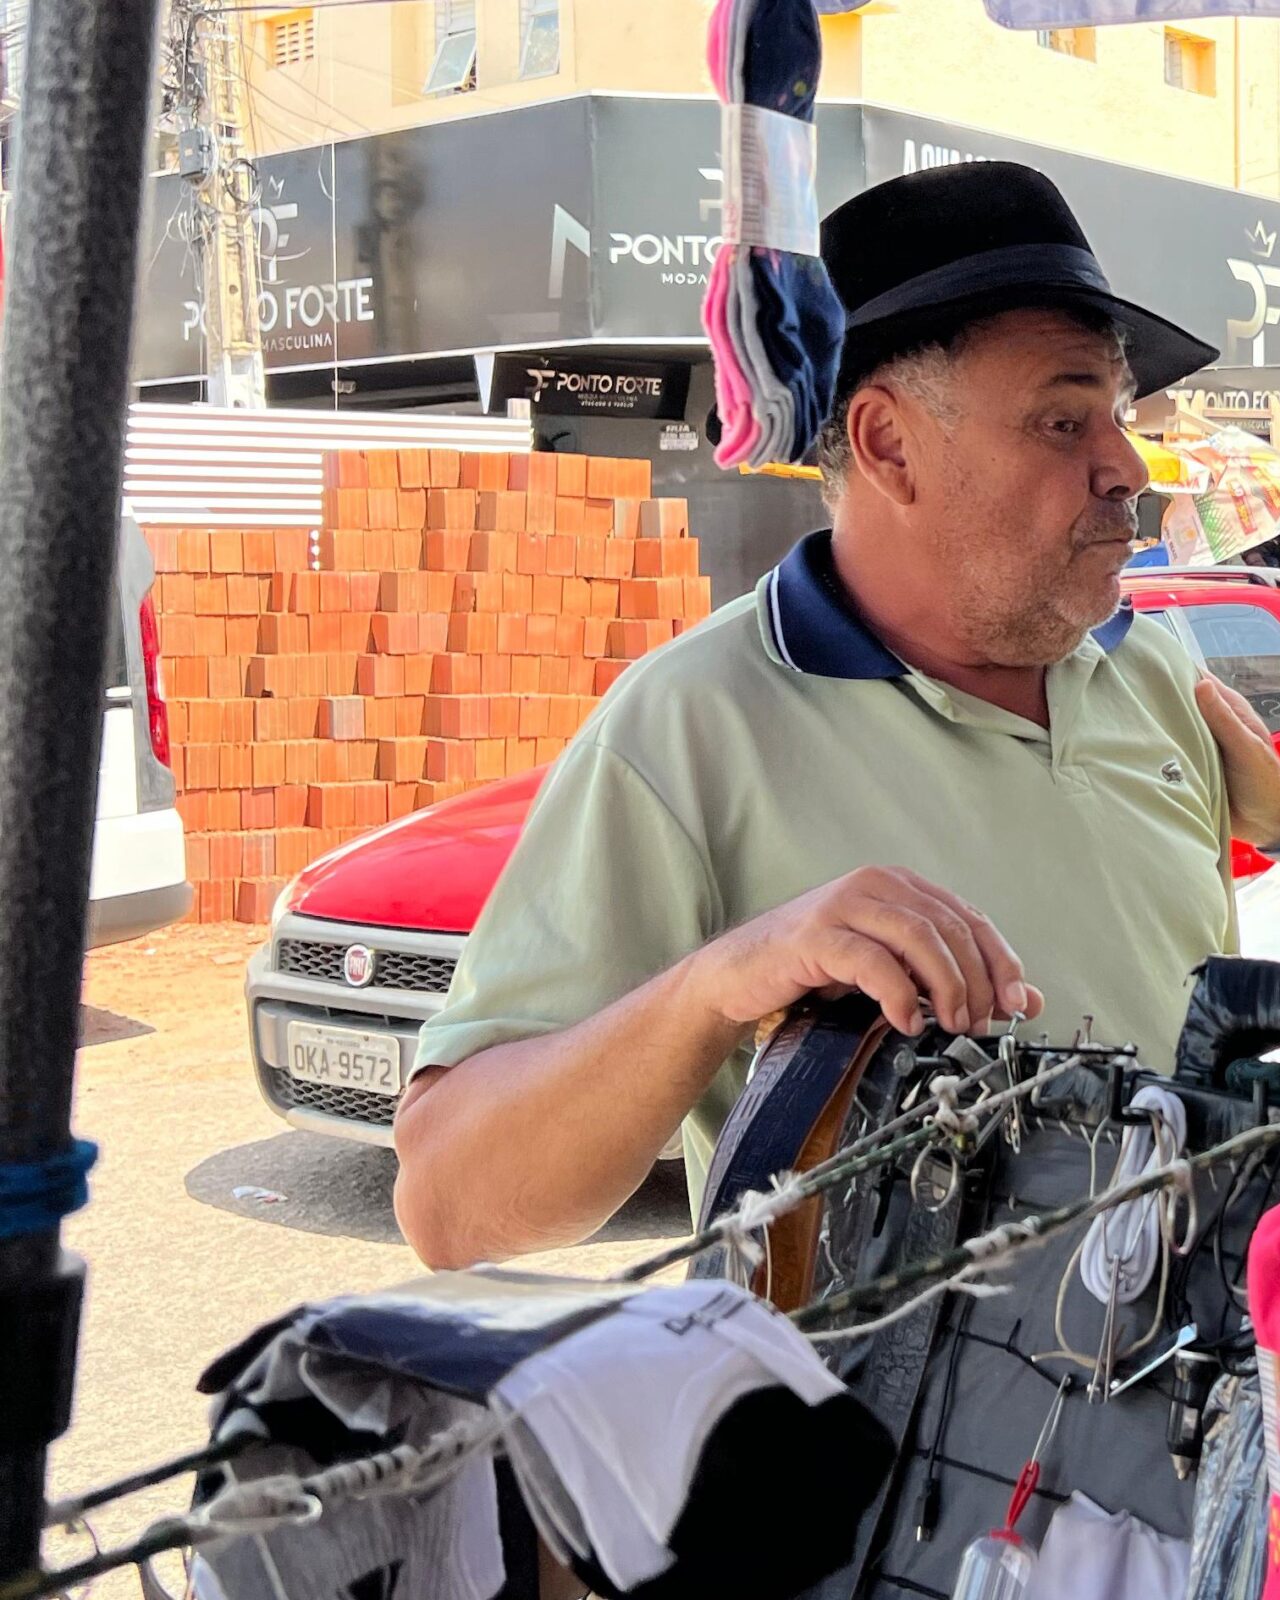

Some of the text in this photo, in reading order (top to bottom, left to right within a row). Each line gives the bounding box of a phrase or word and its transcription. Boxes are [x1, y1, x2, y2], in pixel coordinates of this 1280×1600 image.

[662, 273, 708, 285] MODA
[285, 277, 375, 329] FORTE
[557, 373, 663, 396] PONTO FORTE
